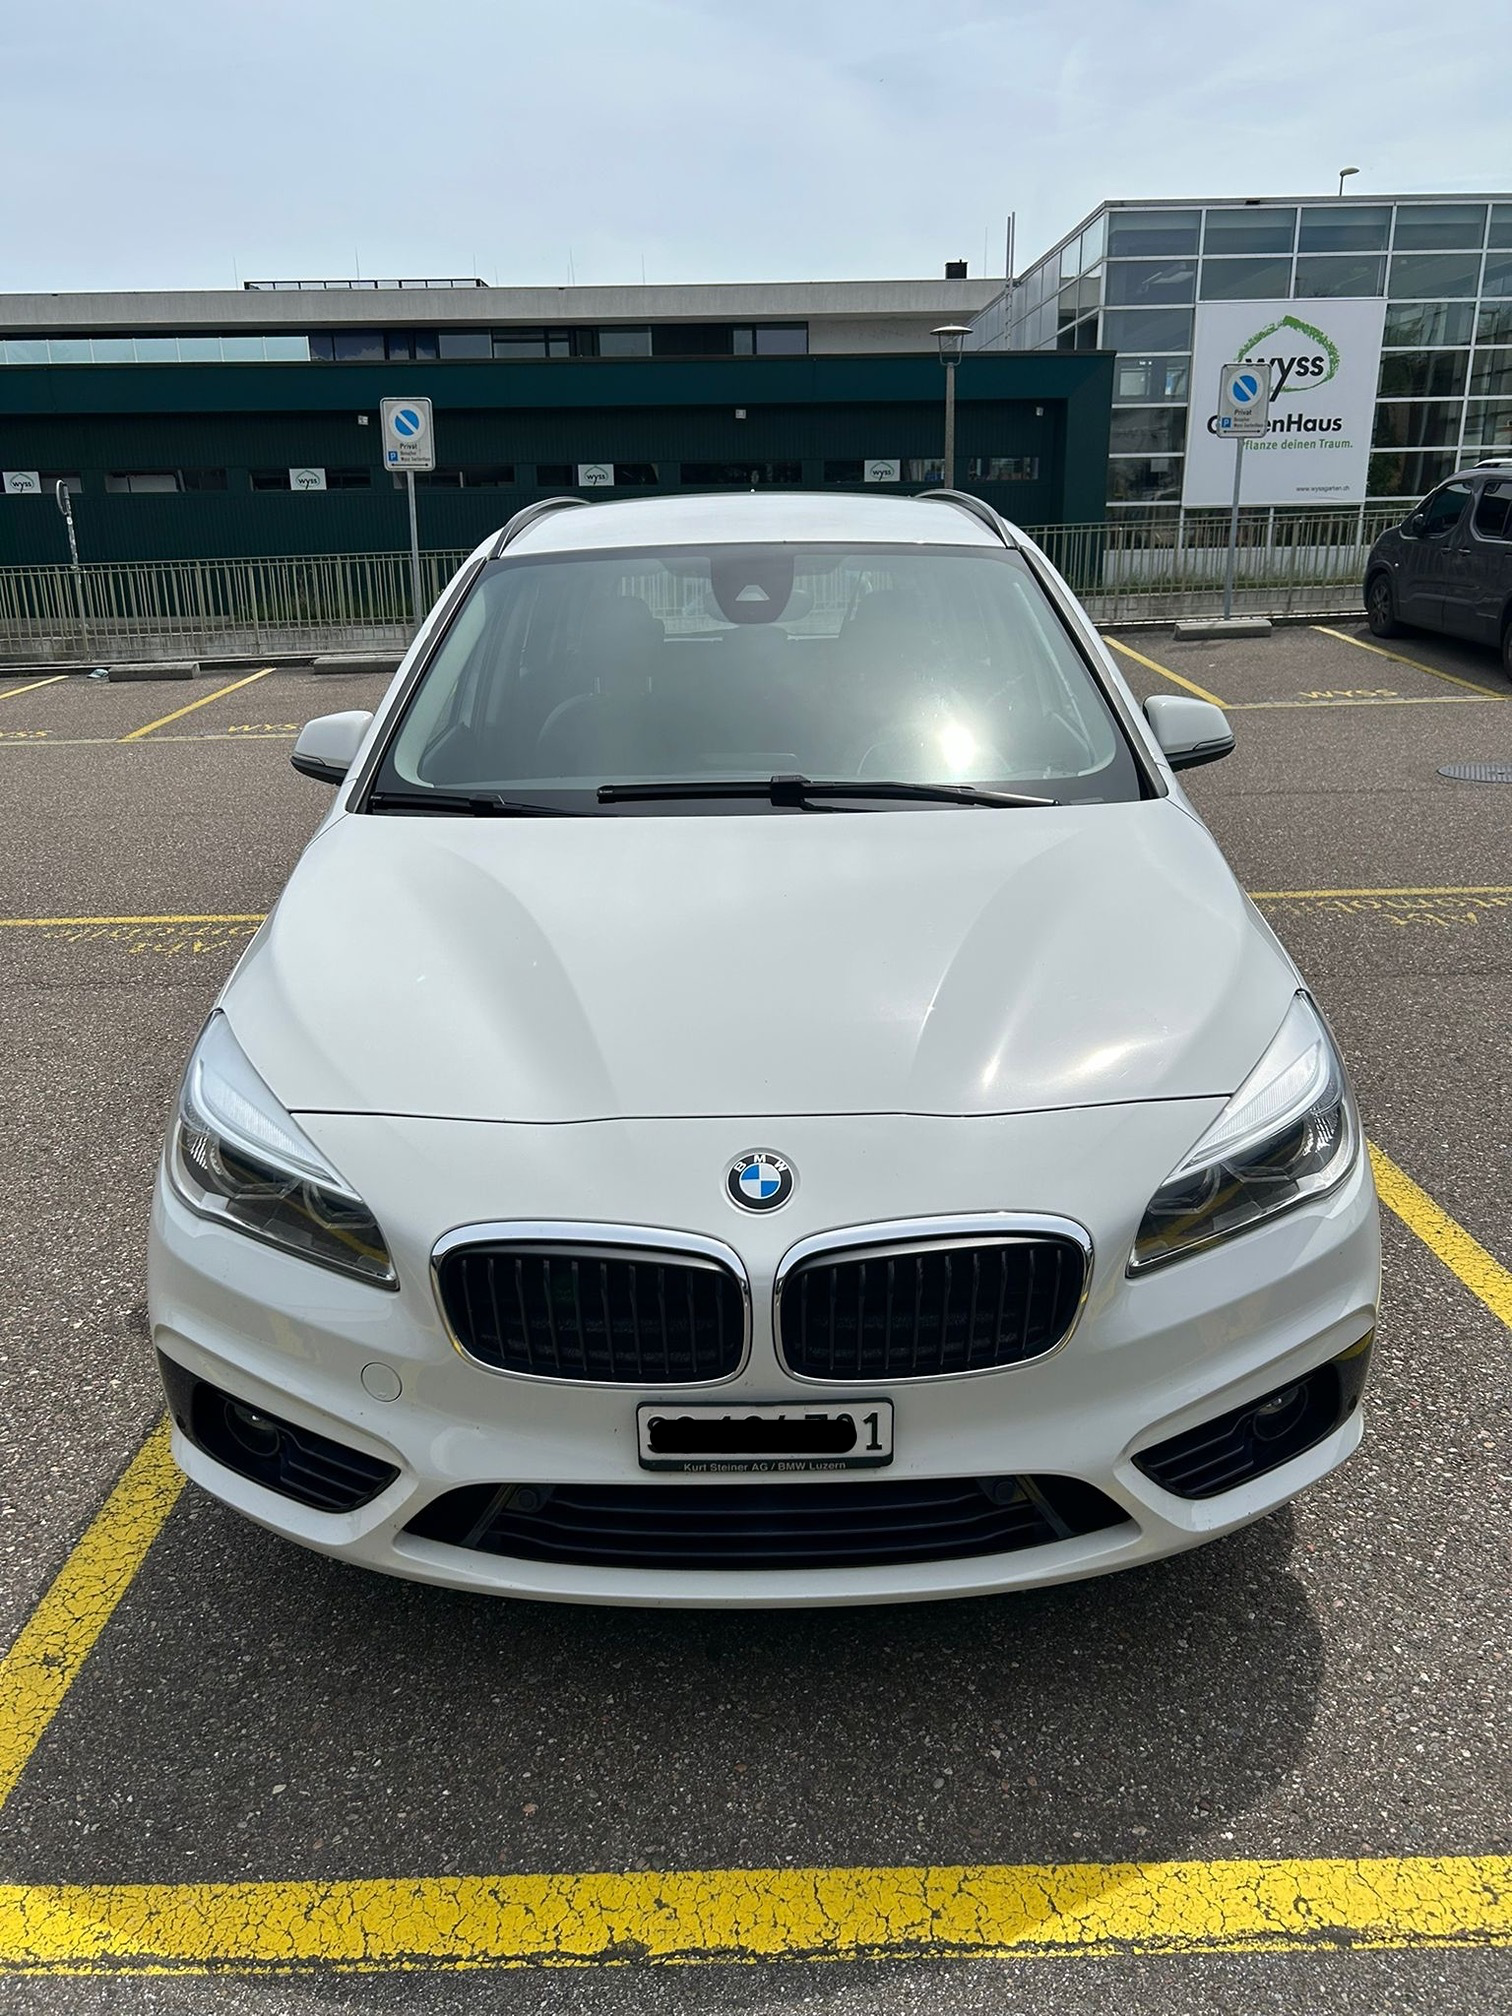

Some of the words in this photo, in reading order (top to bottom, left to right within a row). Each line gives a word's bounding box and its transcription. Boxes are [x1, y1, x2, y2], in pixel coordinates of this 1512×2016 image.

[1243, 439, 1278, 450] flanze
[1281, 438, 1316, 449] deinen
[1319, 438, 1354, 449] Traum.
[586, 474, 606, 485] wyss
[872, 470, 892, 481] wyss
[12, 481, 32, 492] wyss
[298, 478, 318, 489] wyss
[1299, 689, 1399, 699] WYSS
[228, 723, 303, 732] WYS
[733, 1154, 788, 1173] BMW
[683, 1463, 708, 1472] Kurt
[709, 1463, 748, 1472] Steiner
[751, 1462, 768, 1471] AG
[770, 1462, 776, 1471] /
[778, 1462, 806, 1471] BMW
[809, 1461, 846, 1471] Luzern
